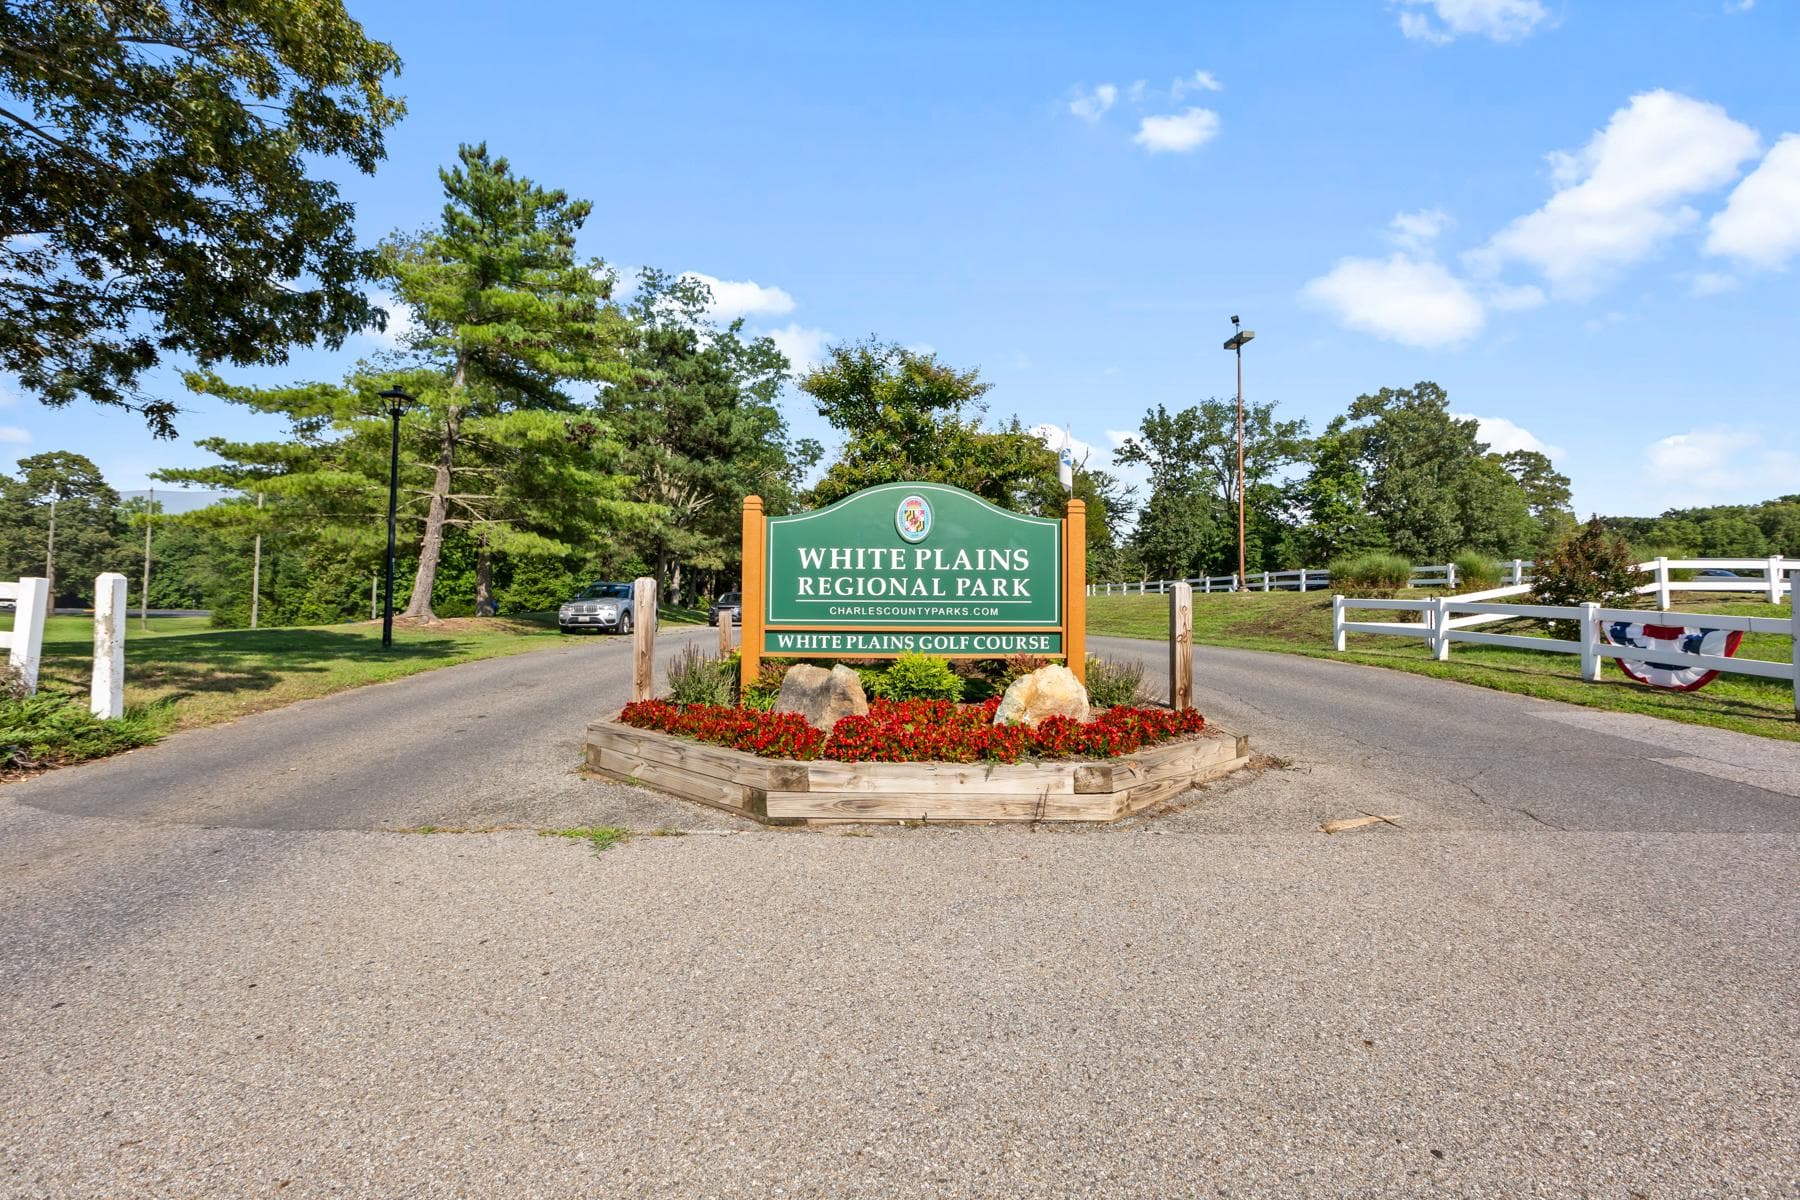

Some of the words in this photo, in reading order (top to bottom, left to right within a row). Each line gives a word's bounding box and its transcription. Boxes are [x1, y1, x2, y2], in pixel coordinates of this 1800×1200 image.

[798, 548, 905, 570] WHITE
[915, 549, 1029, 571] PLAINS
[798, 577, 945, 596] REGIONAL
[956, 578, 1030, 597] PARK
[829, 606, 999, 616] CHARLESCOUNTYPARKS.COM
[778, 635, 841, 648] WHITE
[846, 635, 914, 649] PLAINS
[919, 636, 969, 650] GOLF
[973, 636, 1049, 650] COURSE
